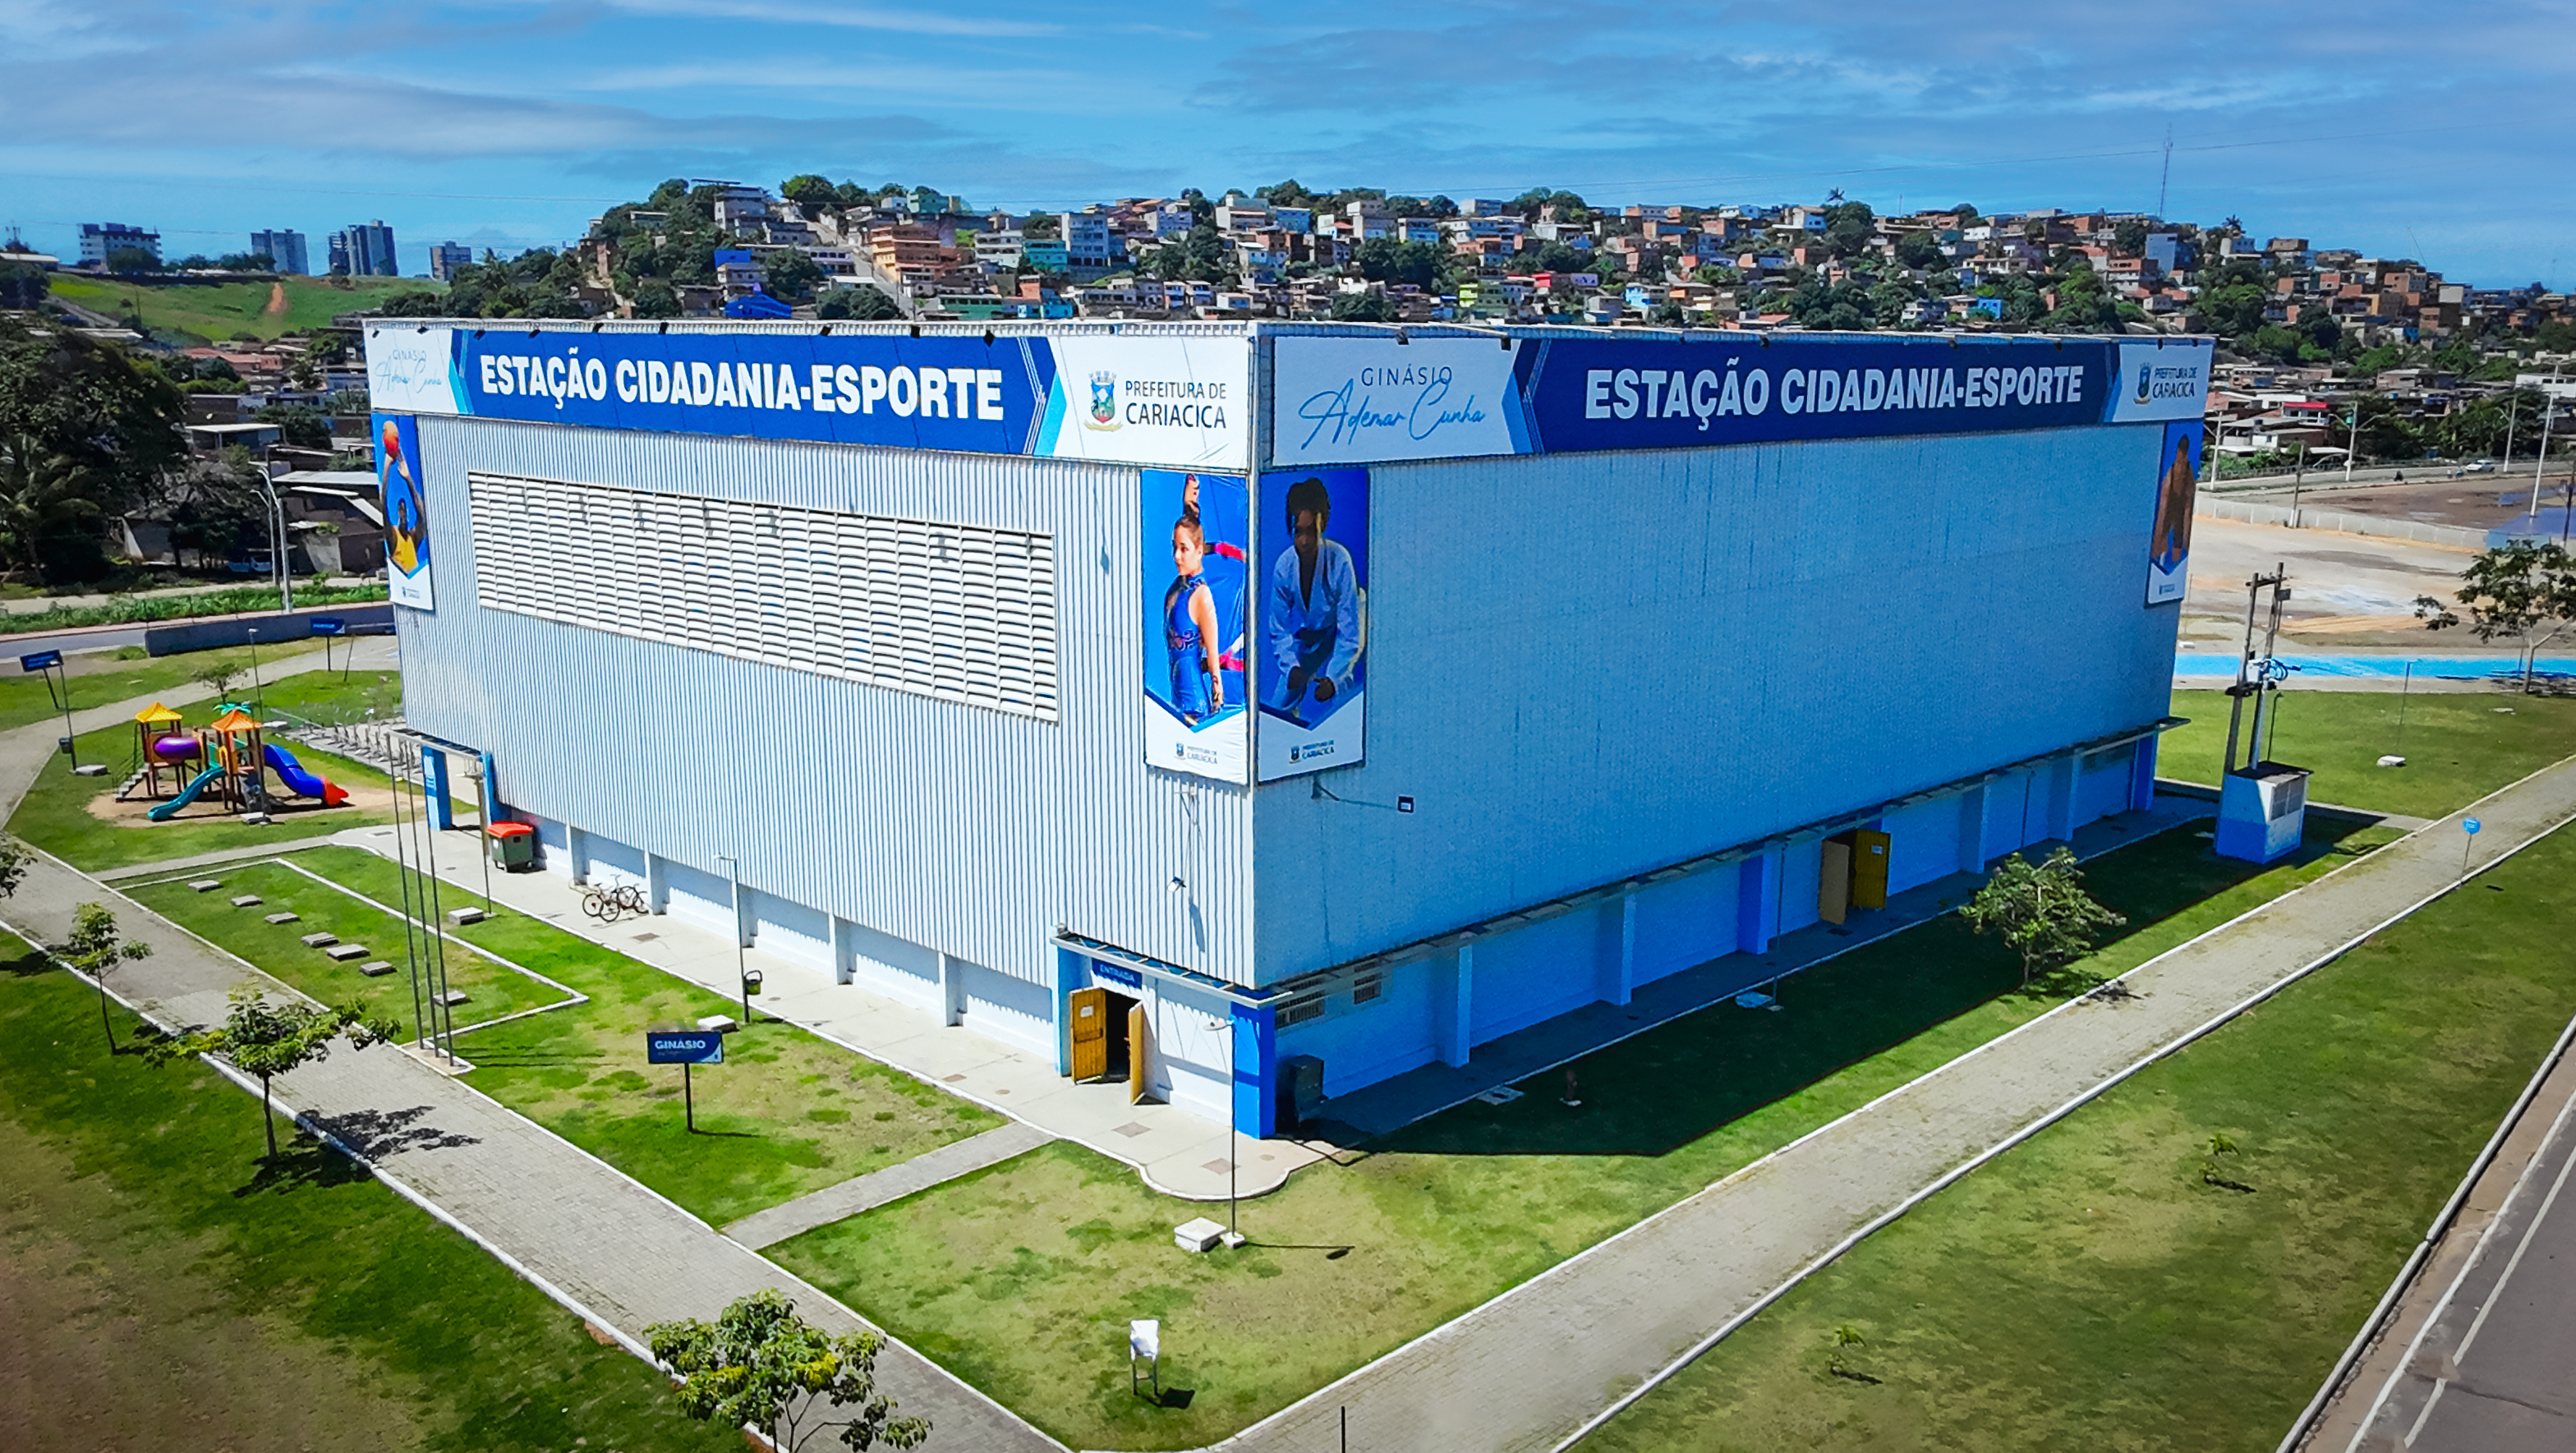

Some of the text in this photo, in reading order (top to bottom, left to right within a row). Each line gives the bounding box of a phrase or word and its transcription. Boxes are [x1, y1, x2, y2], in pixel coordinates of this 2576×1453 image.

[481, 347, 1004, 420] ESTAÇÃO CIDADANIA-ESPORTE
[1361, 364, 1451, 387] GINÁSIO
[1125, 380, 1226, 399] PREFEITURA DE
[1586, 357, 2084, 430] ESTAÇÃO CIDADANIA-ESPORTE
[1126, 402, 1226, 429] CARIACICA
[1409, 378, 1486, 440] Cunha
[655, 1037, 706, 1050] GINÁSIO
